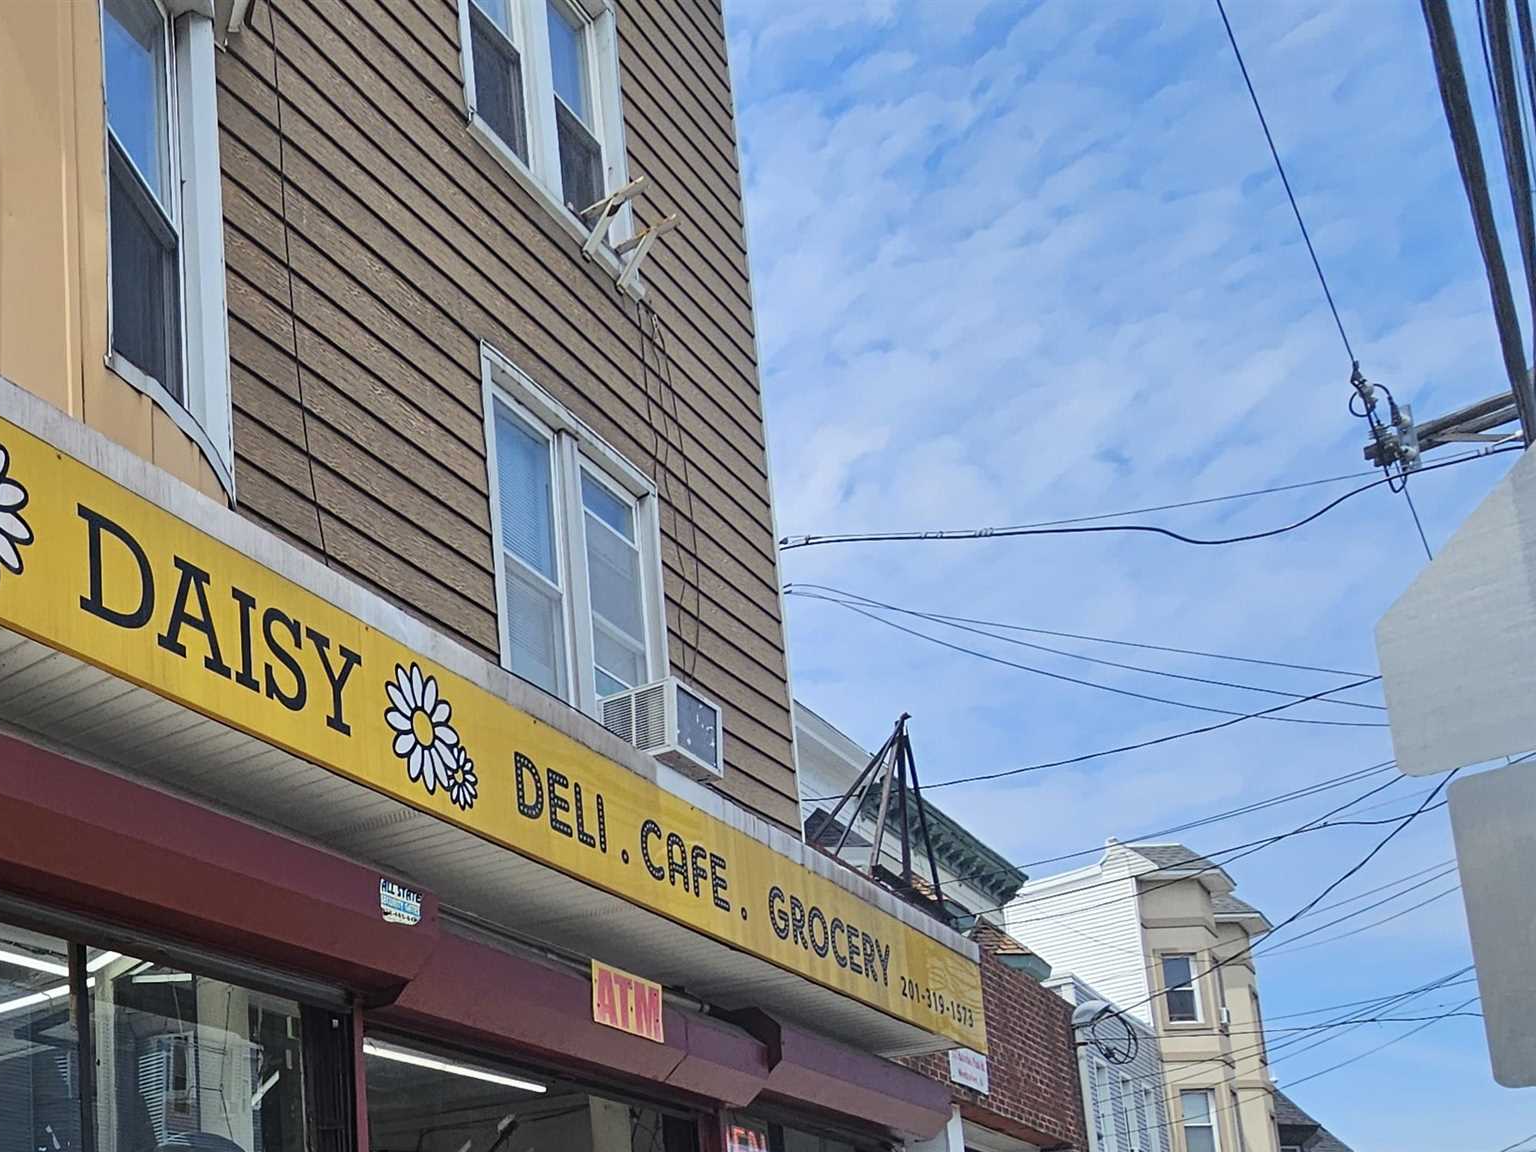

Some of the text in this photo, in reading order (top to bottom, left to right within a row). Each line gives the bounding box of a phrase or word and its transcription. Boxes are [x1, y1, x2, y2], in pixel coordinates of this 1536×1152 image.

[77, 502, 362, 736] DAISY
[514, 751, 890, 987] DELI CAFE GROCERY
[595, 965, 663, 1040] ATM
[900, 975, 975, 1028] 201-319-1573
